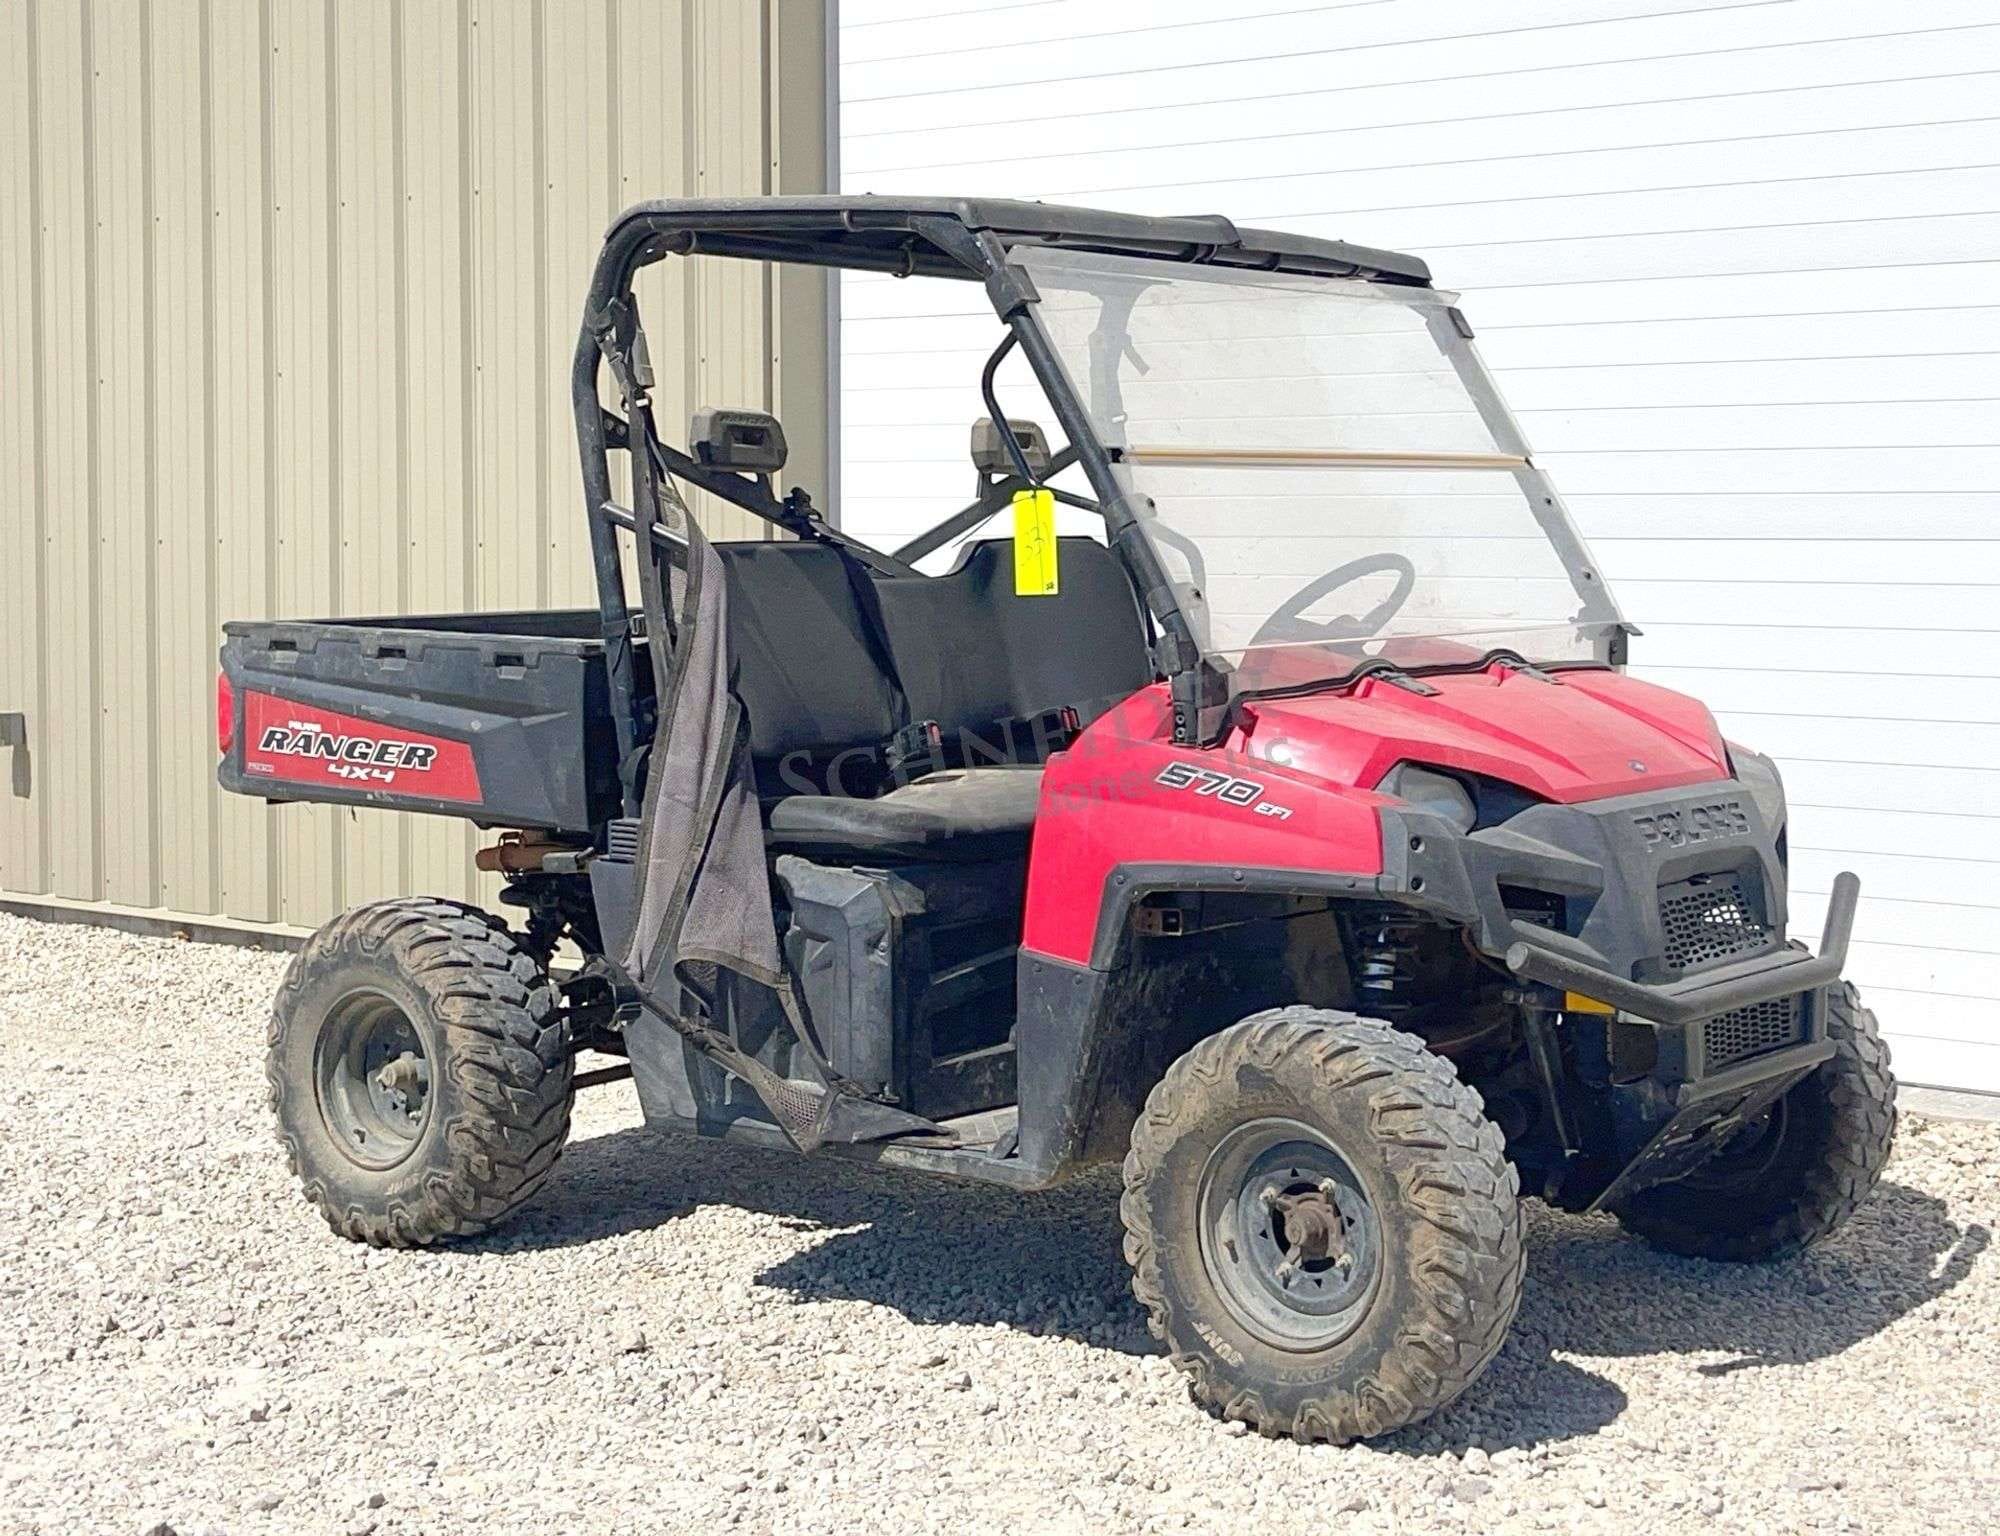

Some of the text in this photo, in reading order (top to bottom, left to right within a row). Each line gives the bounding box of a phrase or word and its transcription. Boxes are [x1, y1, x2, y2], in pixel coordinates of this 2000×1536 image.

[258, 726, 437, 771] RANGER
[327, 763, 395, 783] 4X4
[1154, 761, 1265, 807] 570
[1633, 802, 1751, 852] POLARIS
